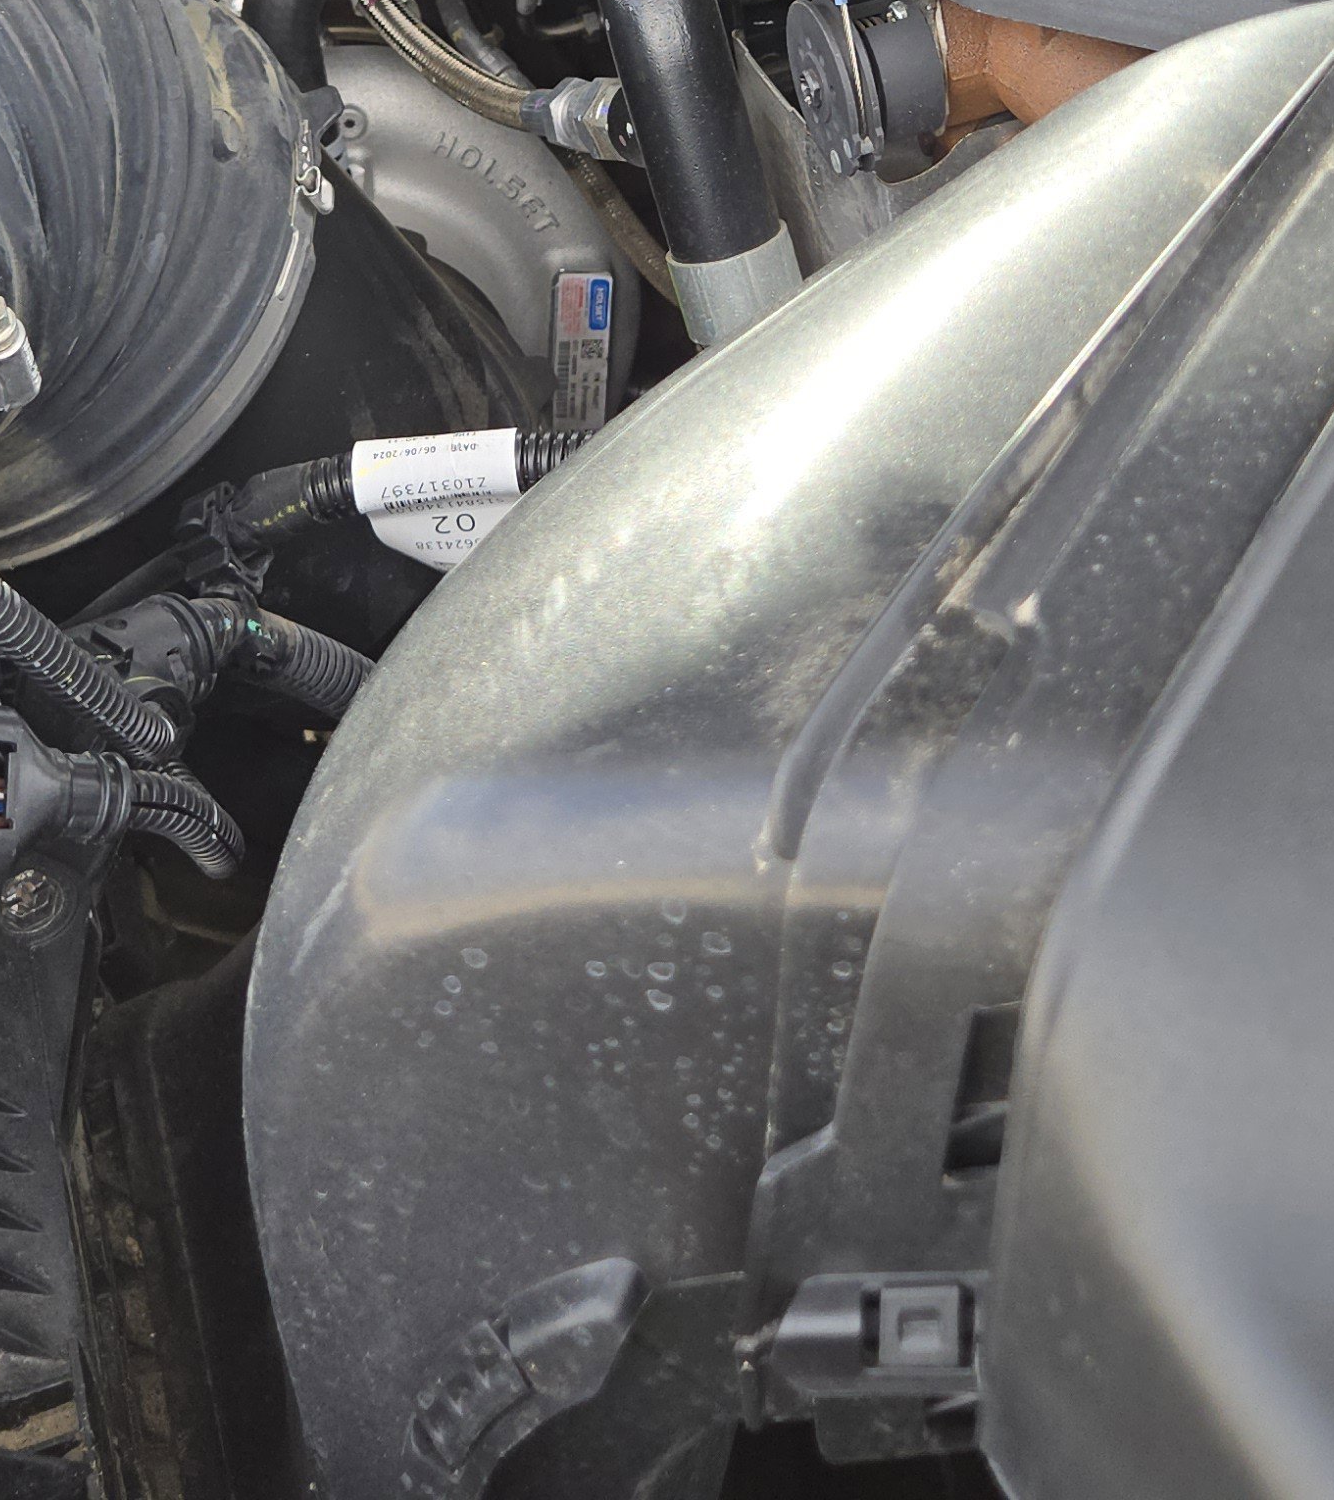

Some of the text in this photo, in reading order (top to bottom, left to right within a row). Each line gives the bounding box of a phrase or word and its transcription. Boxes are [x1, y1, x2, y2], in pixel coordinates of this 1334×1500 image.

[434, 131, 560, 232] HOLSET
[373, 445, 436, 460] 06/06/2024
[381, 476, 486, 500] Z10317397
